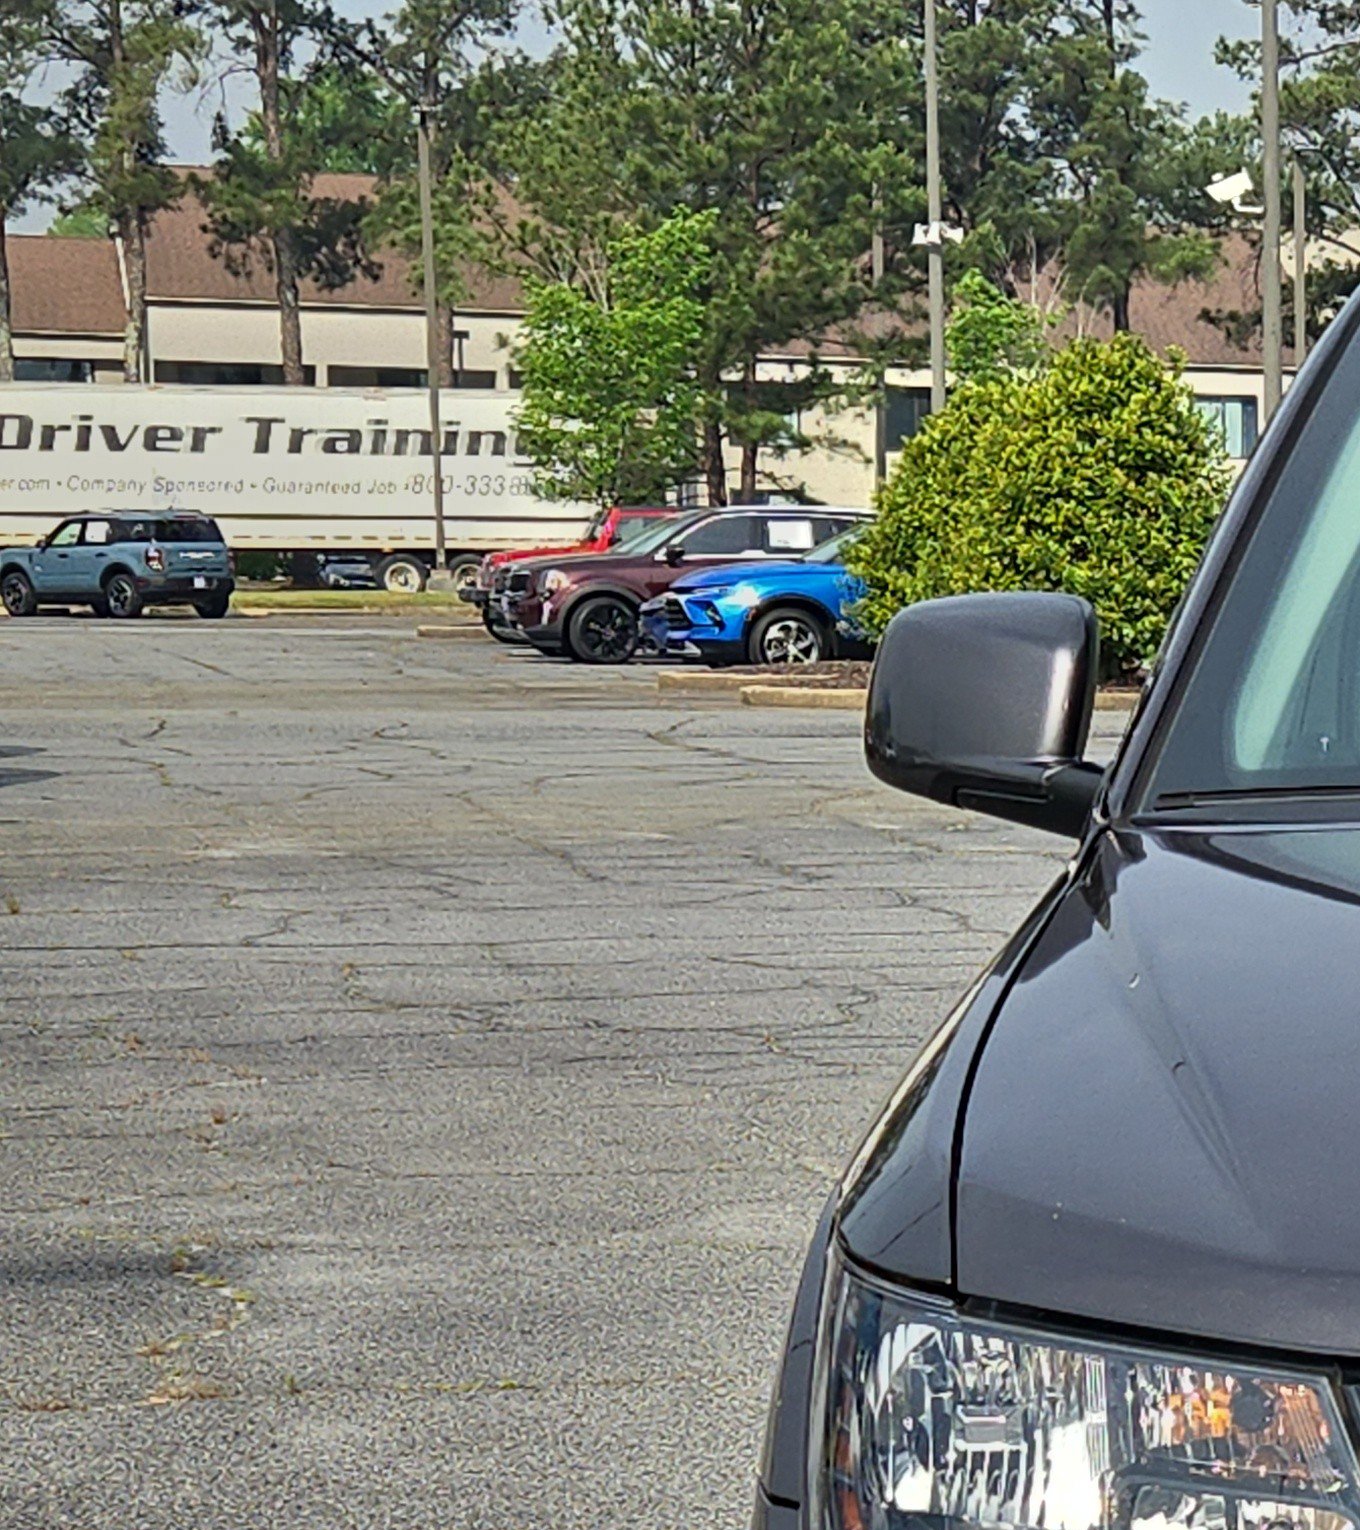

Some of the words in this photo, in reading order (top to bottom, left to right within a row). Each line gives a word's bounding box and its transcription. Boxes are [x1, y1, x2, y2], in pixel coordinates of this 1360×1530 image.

[0, 414, 223, 453] Driver
[66, 474, 147, 495] Company
[152, 476, 244, 496] Sponsored
[262, 476, 361, 495] Guaranteed
